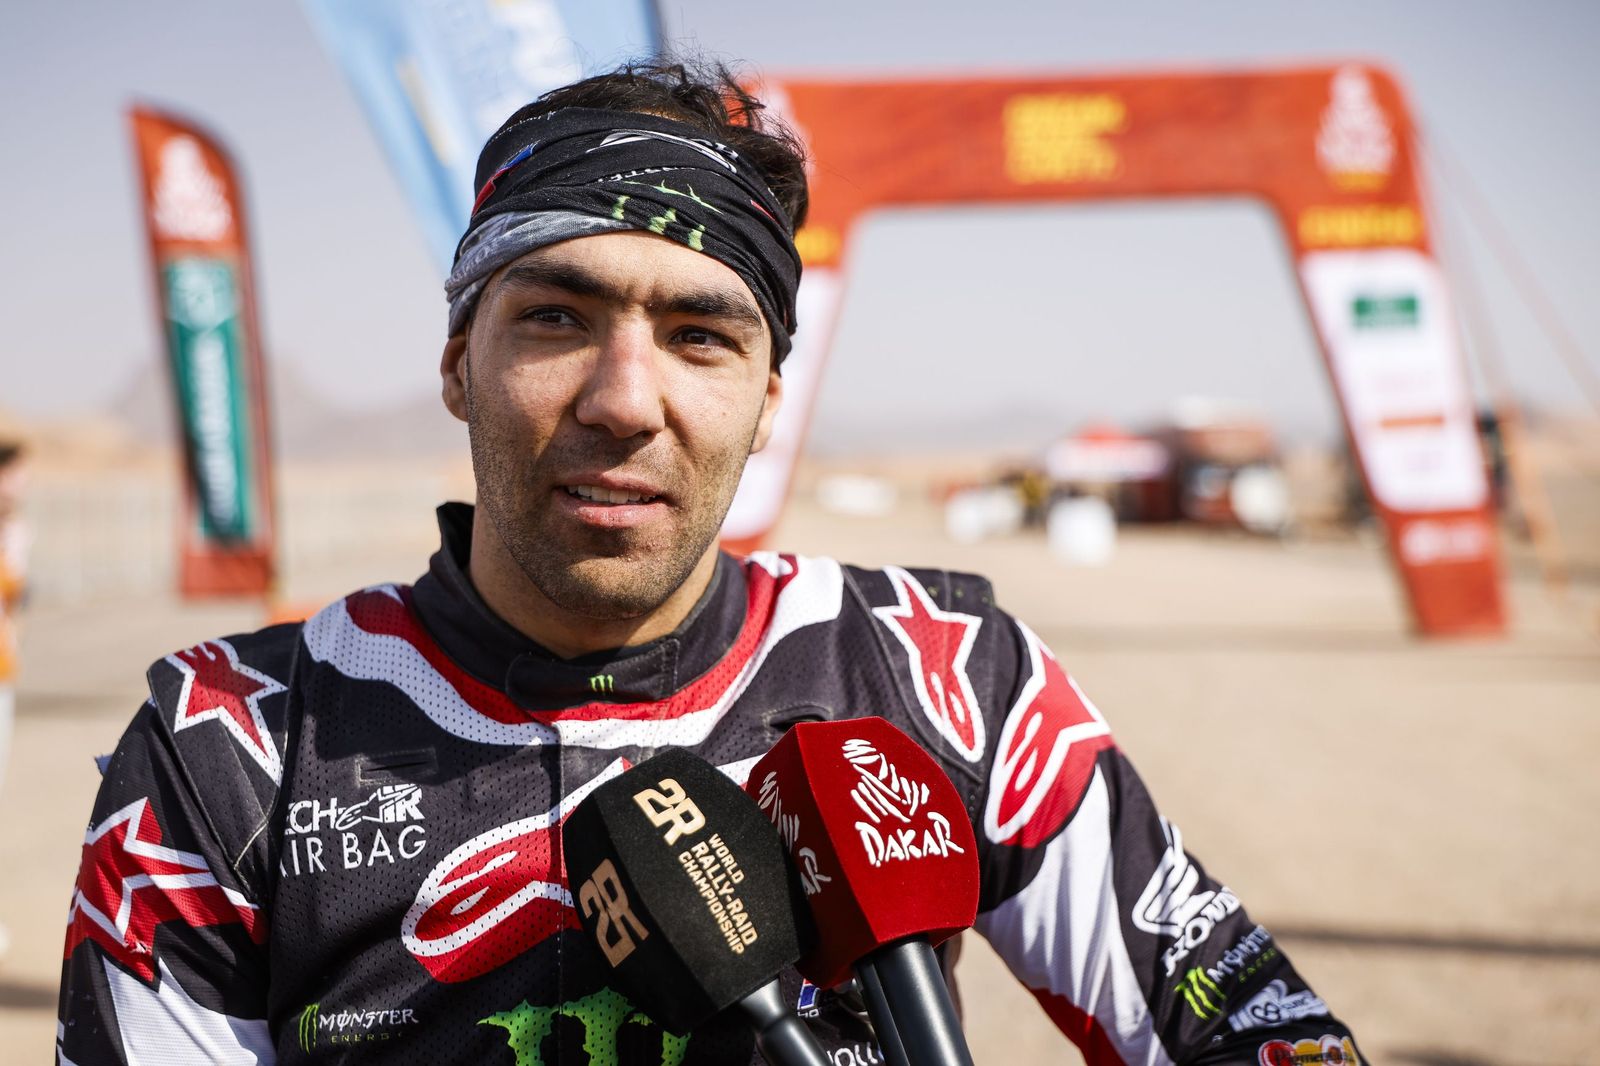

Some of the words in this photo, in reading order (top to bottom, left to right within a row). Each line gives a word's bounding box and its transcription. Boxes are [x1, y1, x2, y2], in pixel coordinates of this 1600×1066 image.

[280, 837, 328, 877] IR
[342, 824, 426, 869] BAG
[708, 833, 745, 884] WORLD
[855, 811, 964, 867] DAKAR
[678, 850, 745, 954] CHAMPIONSHIP
[690, 841, 758, 945] RALLY-RAID
[331, 1031, 402, 1044] ENERG
